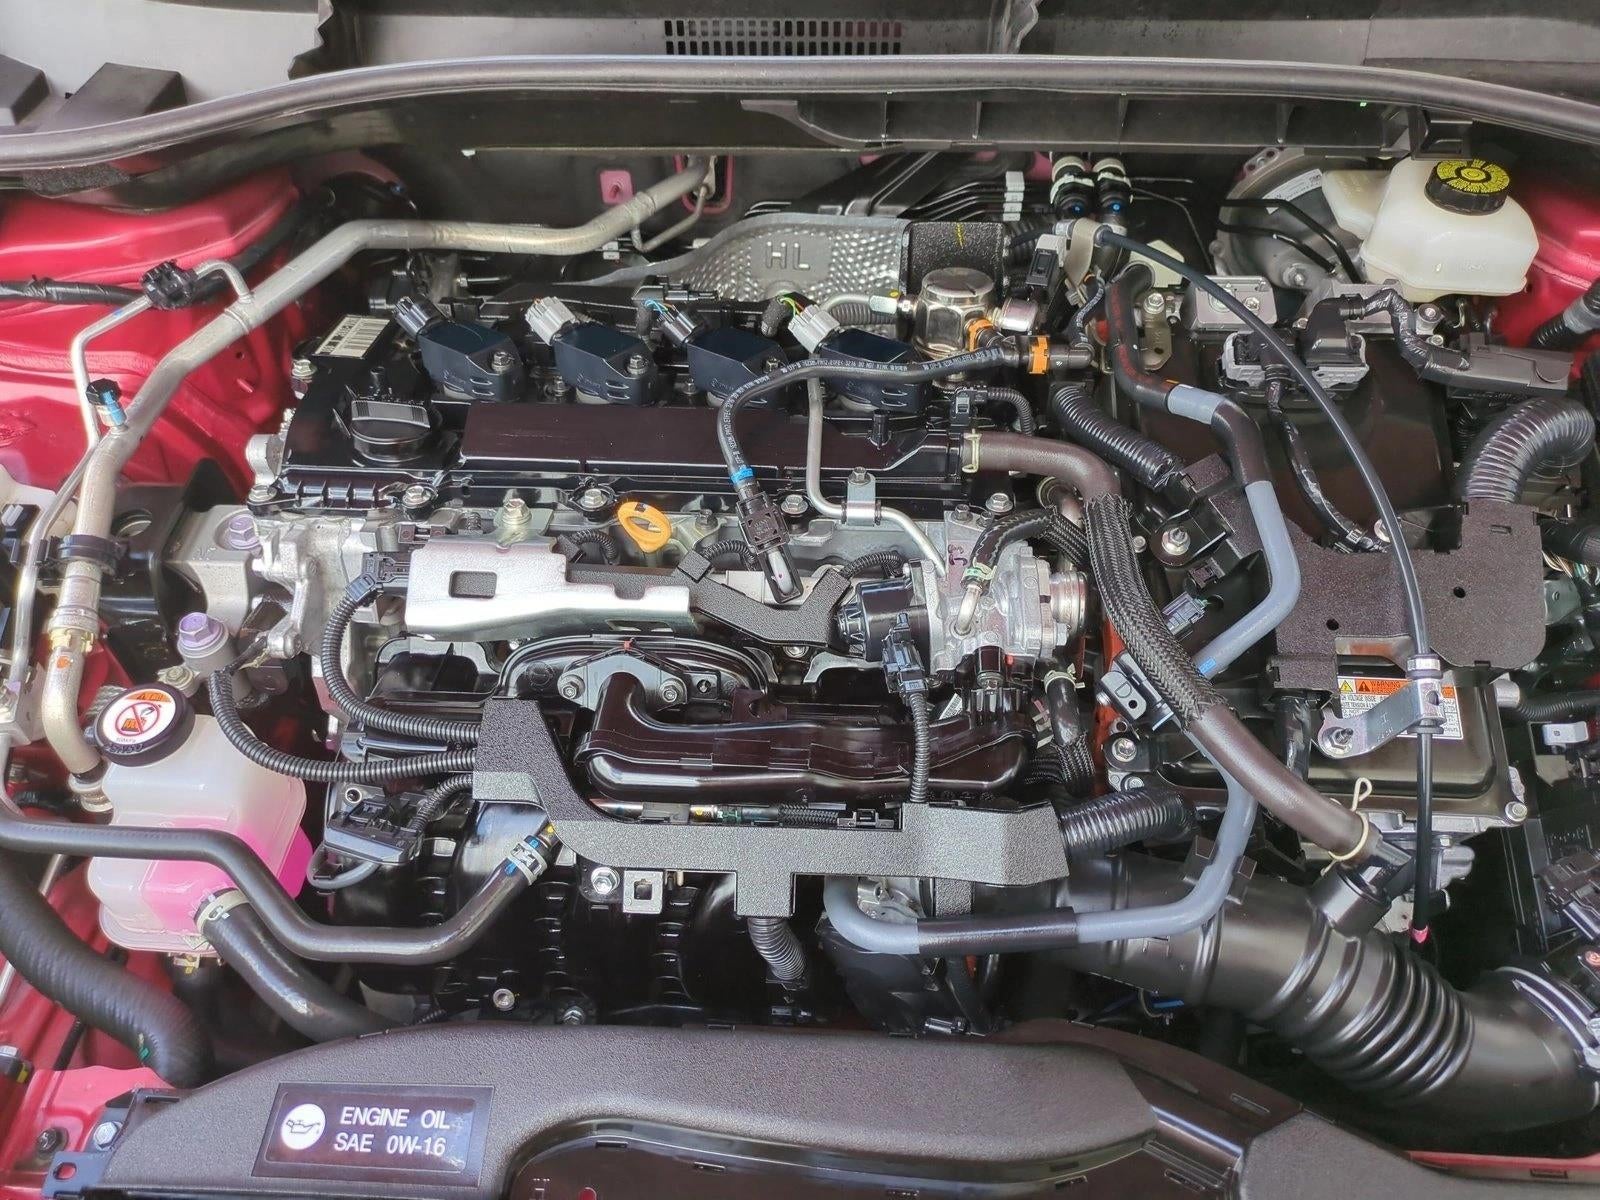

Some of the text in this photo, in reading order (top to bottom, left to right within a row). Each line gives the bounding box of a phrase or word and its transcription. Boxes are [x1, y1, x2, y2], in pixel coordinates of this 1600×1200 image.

[765, 241, 811, 271] HL
[339, 1106, 451, 1130] ENGINE OIL
[333, 1132, 447, 1156] SAE 0W-16
